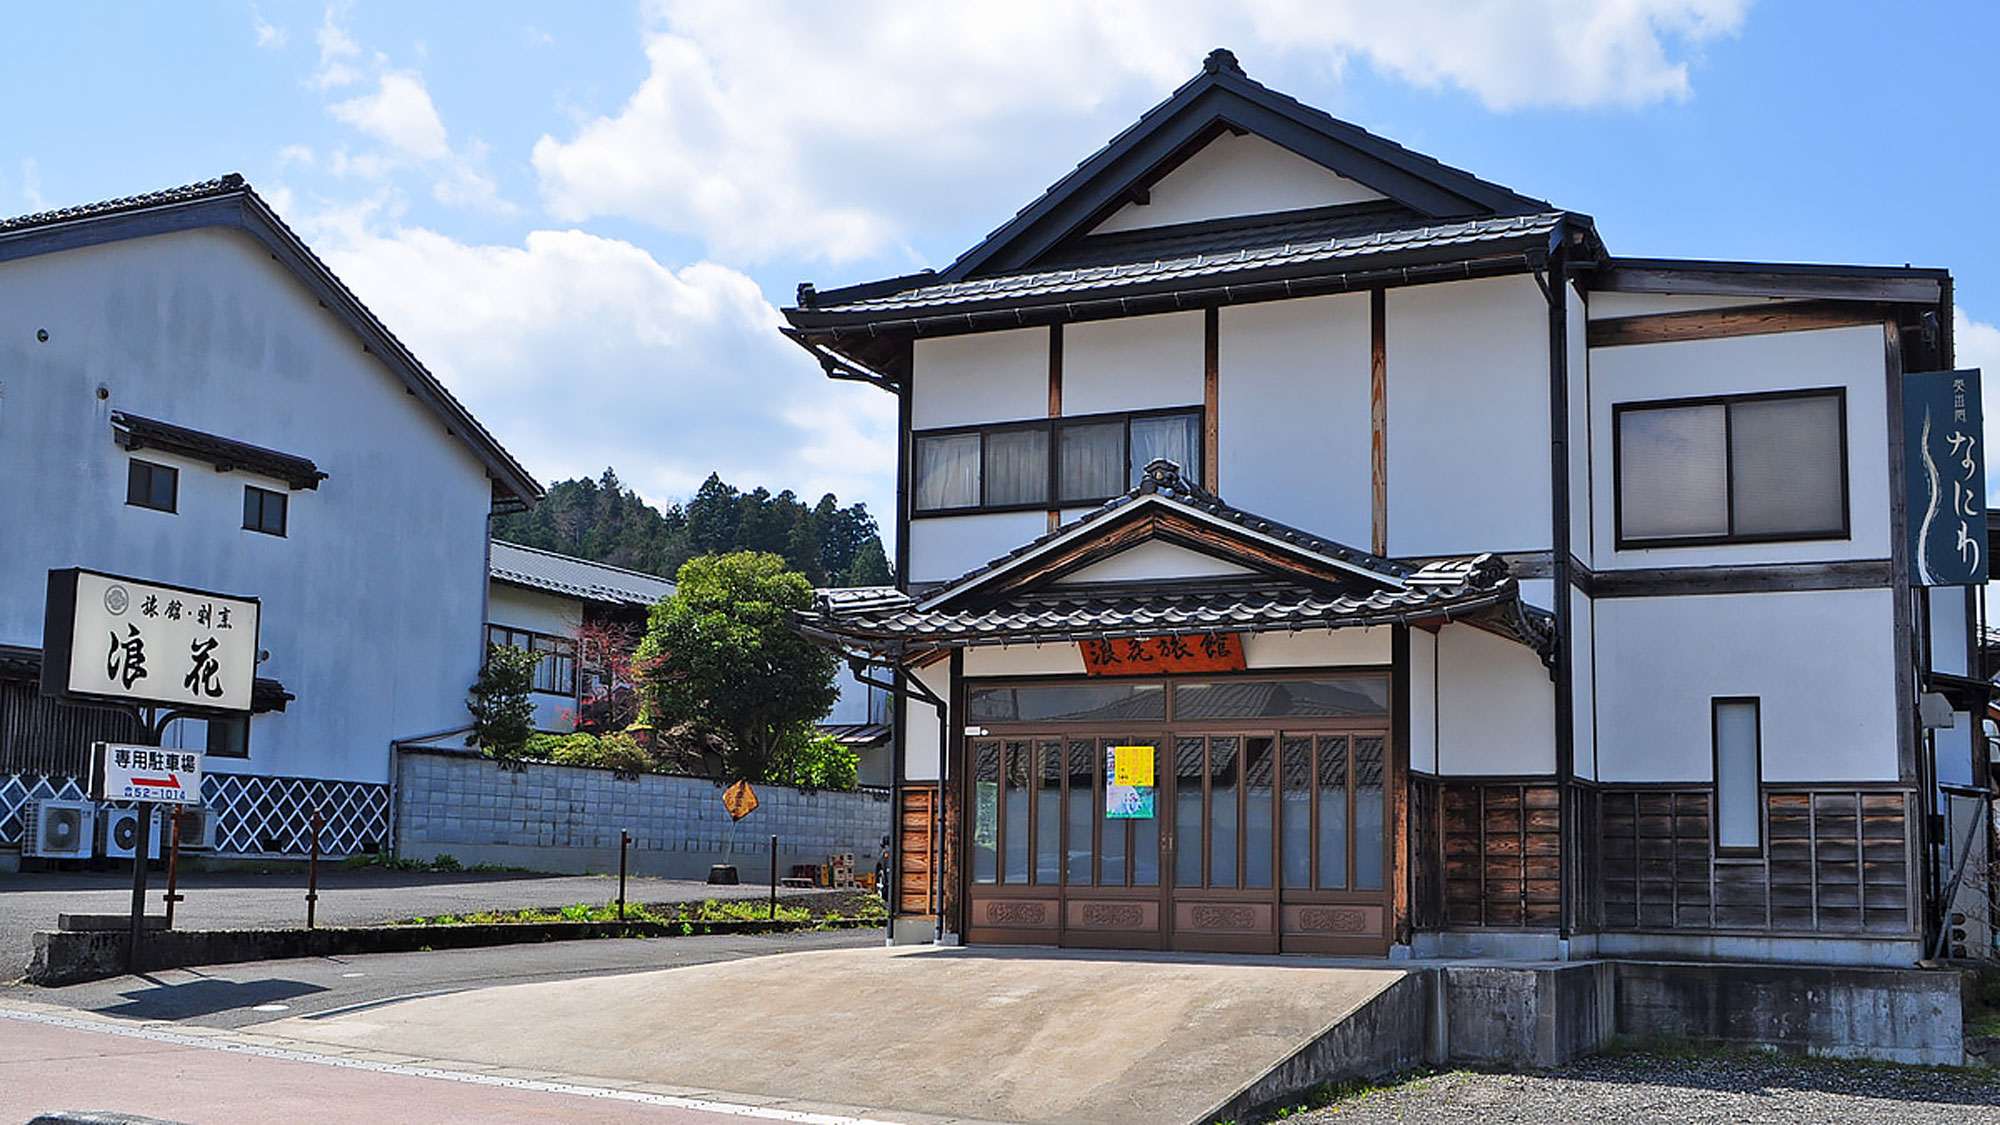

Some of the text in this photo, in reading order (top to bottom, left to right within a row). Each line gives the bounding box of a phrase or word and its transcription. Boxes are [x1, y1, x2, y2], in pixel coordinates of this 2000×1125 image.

[1945, 430, 1980, 577] なにわ
[106, 622, 225, 698] 浪花
[1089, 630, 1231, 666] 浪花旅館
[114, 749, 196, 774] 専用駐車場
[134, 787, 186, 801] 52-1014
